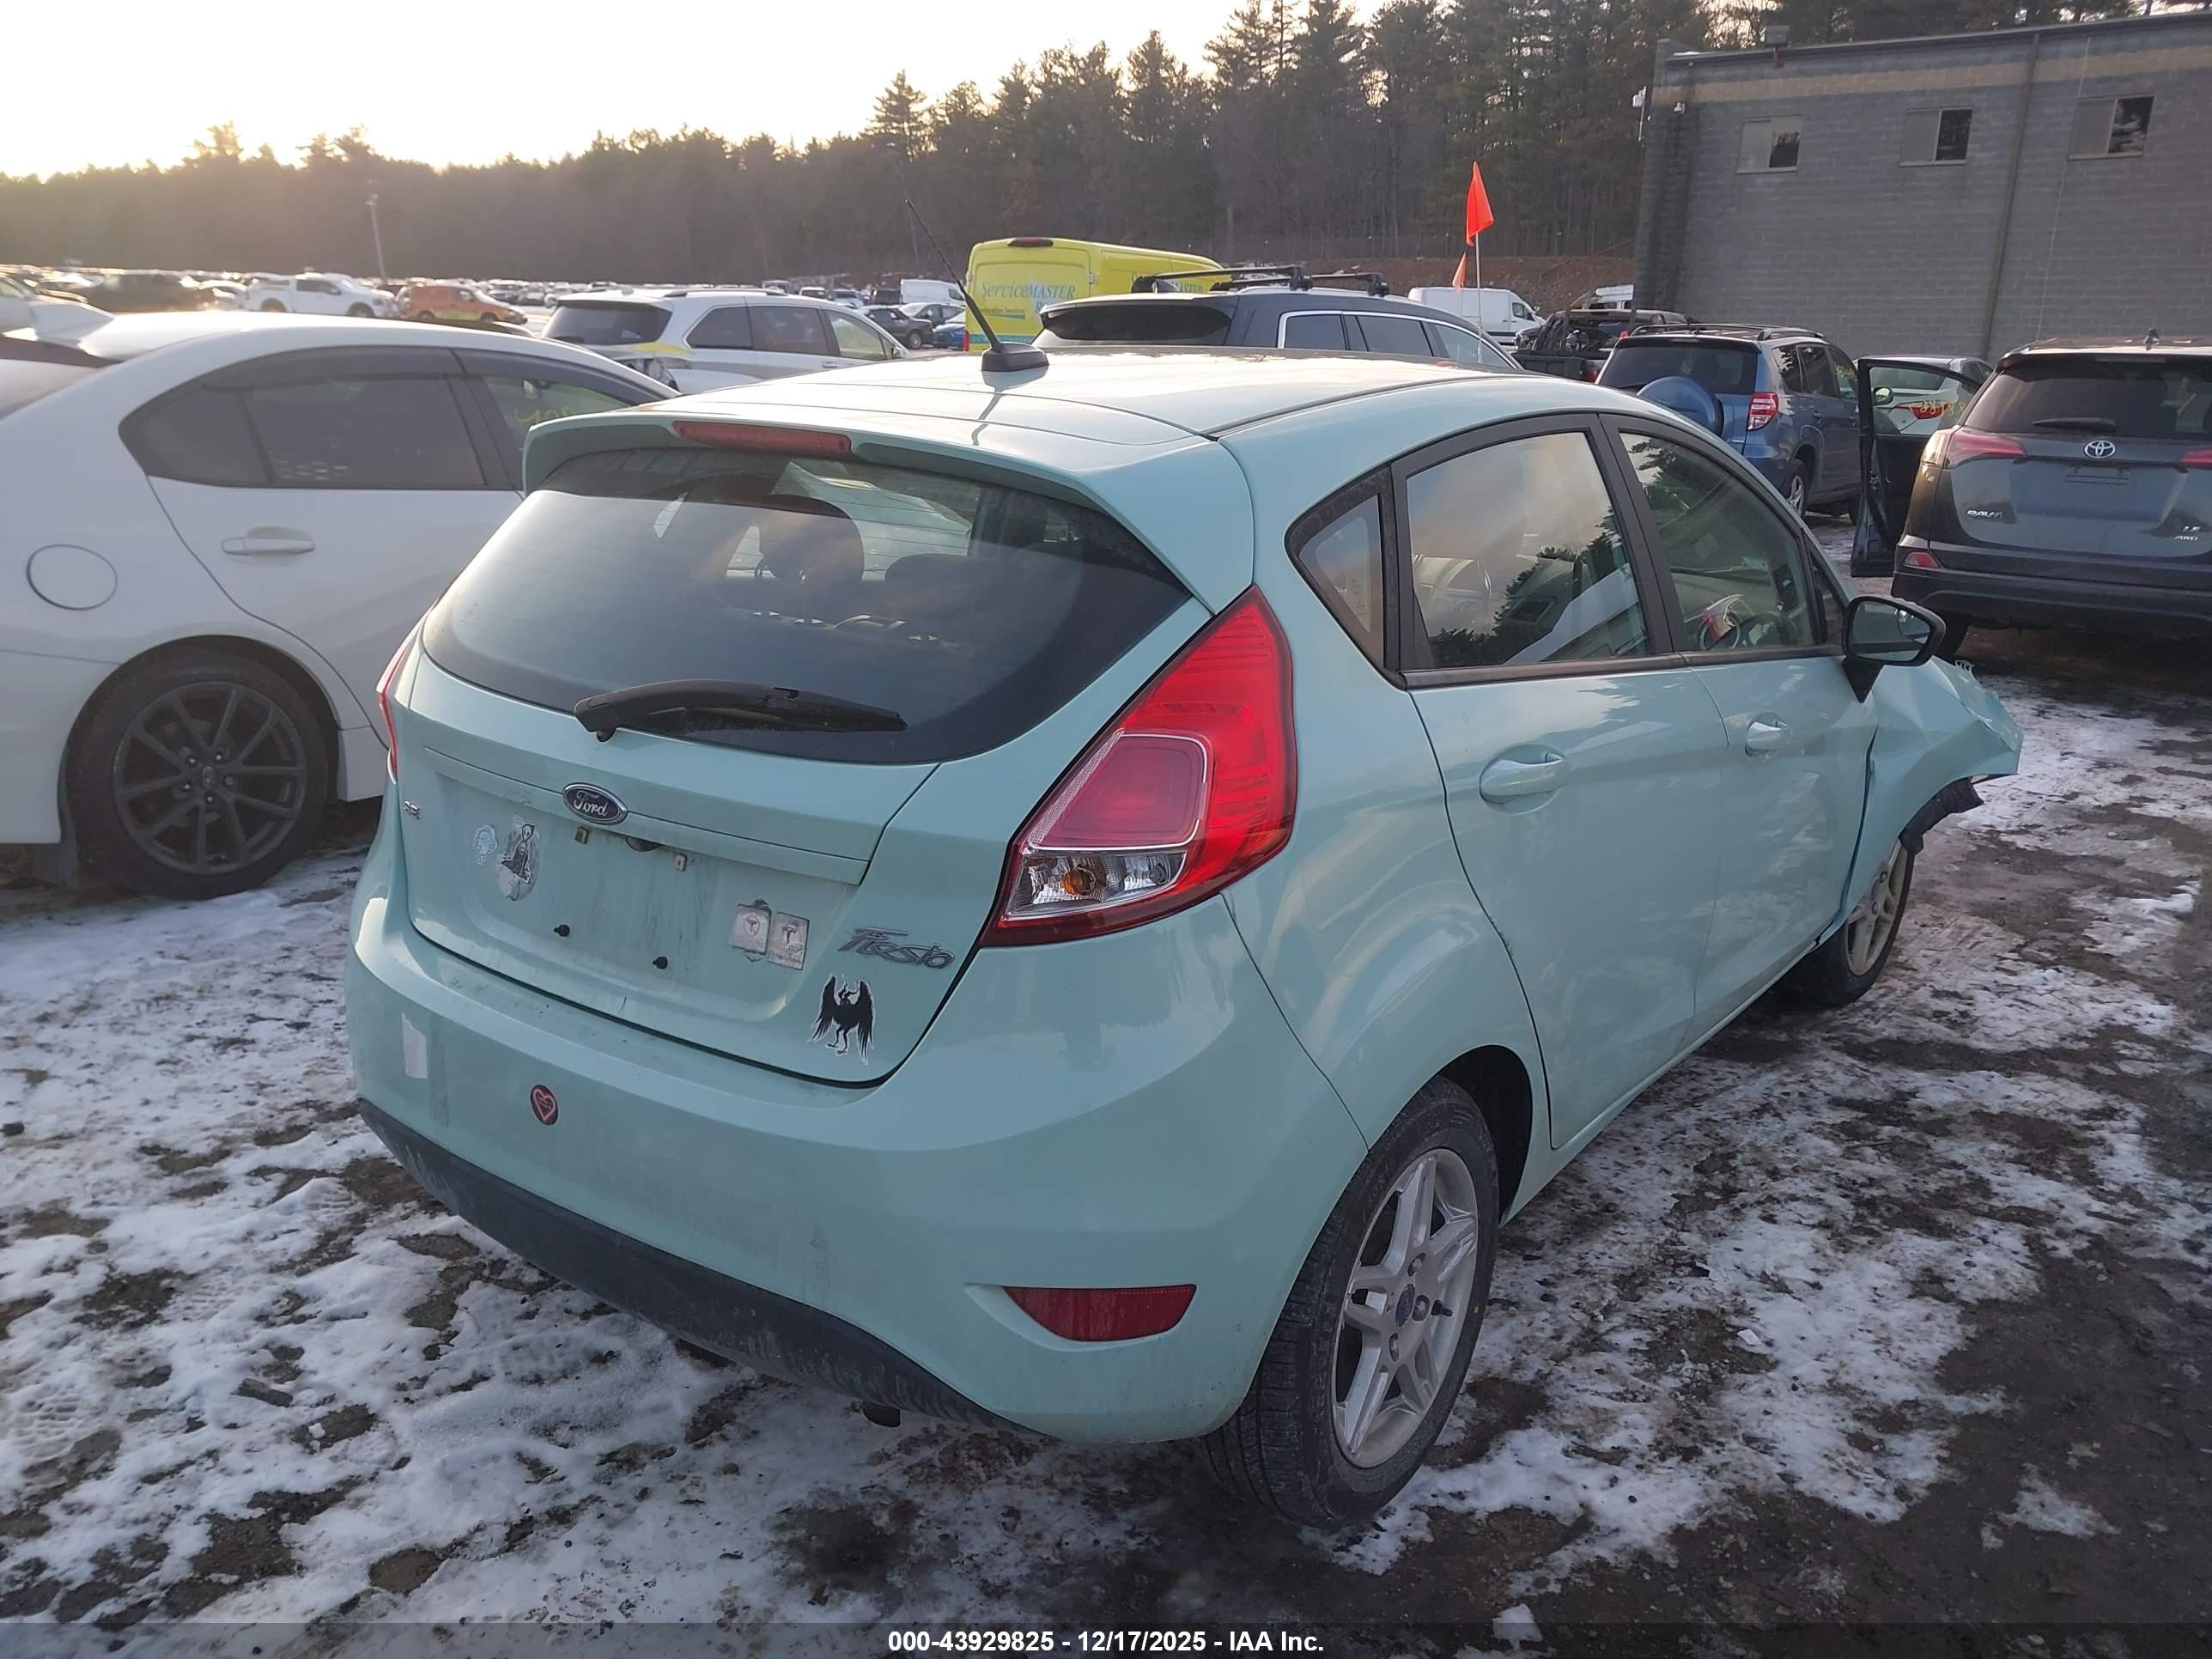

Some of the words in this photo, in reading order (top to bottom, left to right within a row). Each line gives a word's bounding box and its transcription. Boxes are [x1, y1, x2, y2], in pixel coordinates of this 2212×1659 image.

[981, 281, 1076, 299] ServiceMASTER
[573, 790, 609, 817] Ford
[837, 927, 955, 969] Fiesta
